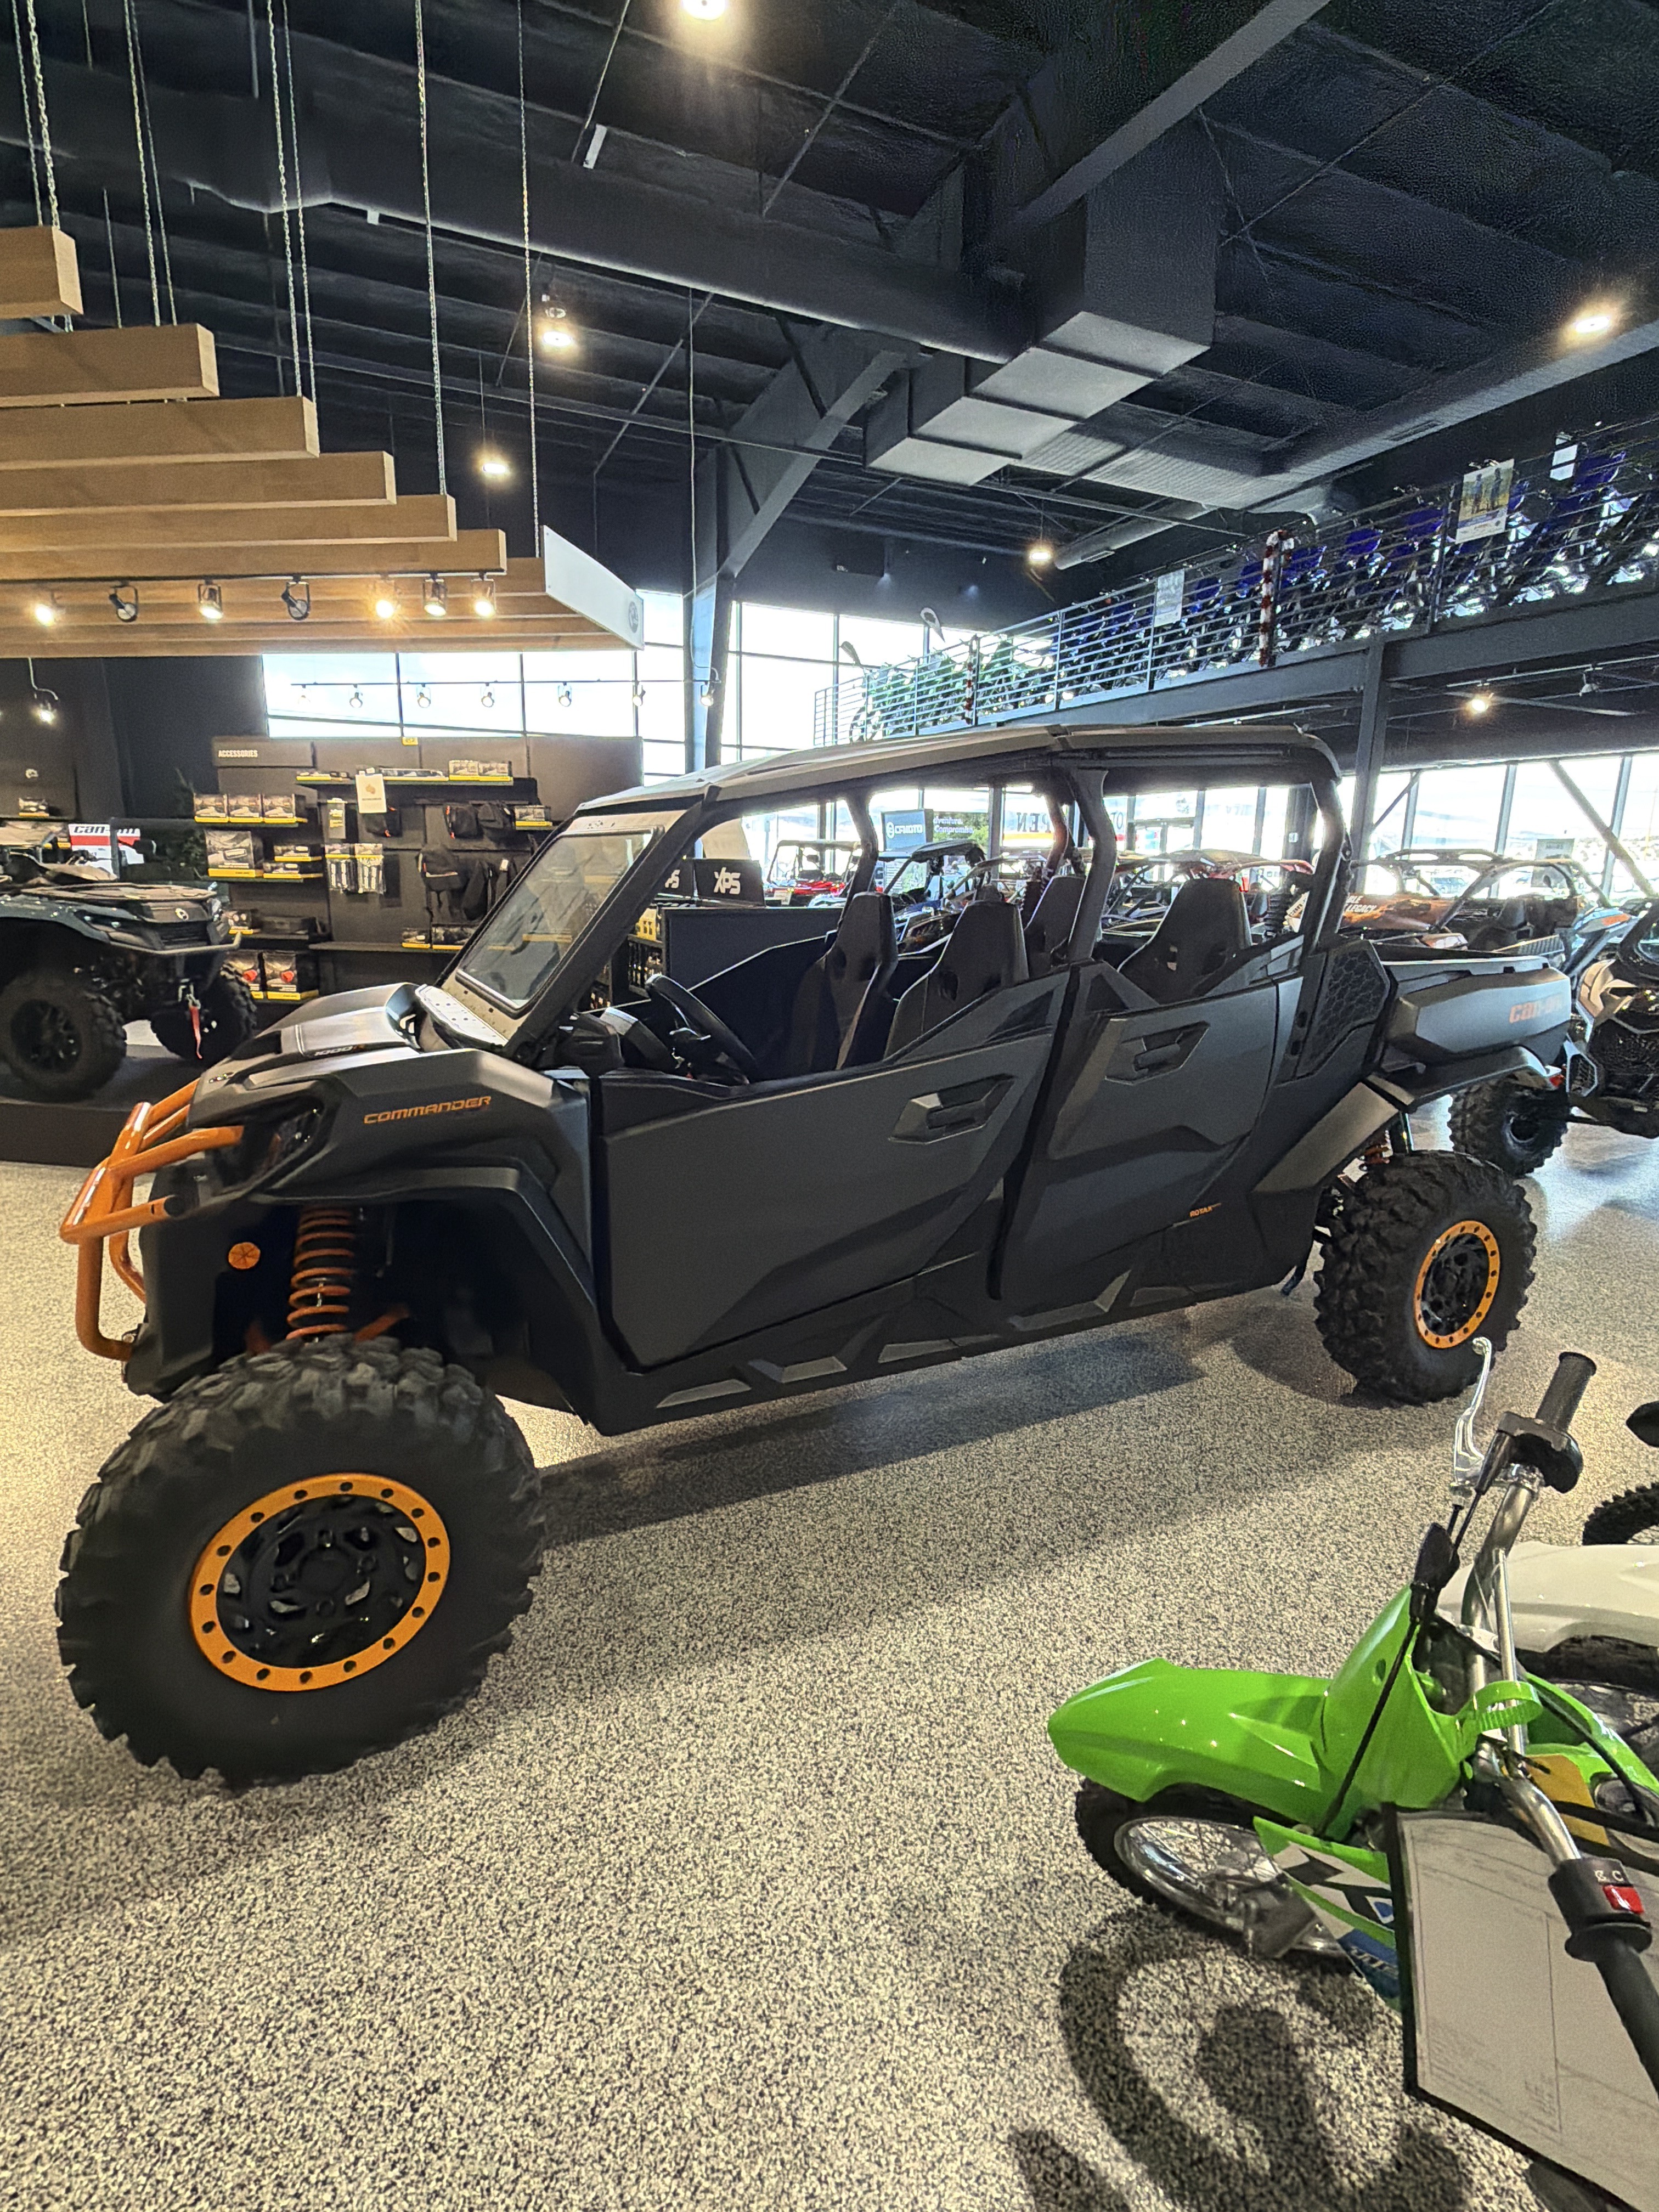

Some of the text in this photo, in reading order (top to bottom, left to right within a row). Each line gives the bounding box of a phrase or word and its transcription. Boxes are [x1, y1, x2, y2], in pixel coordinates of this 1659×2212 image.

[895, 824, 923, 834] CFMOTO
[714, 867, 741, 894] XPS
[1346, 904, 1378, 913] LEGACY
[364, 1096, 491, 1124] COMMANDER
